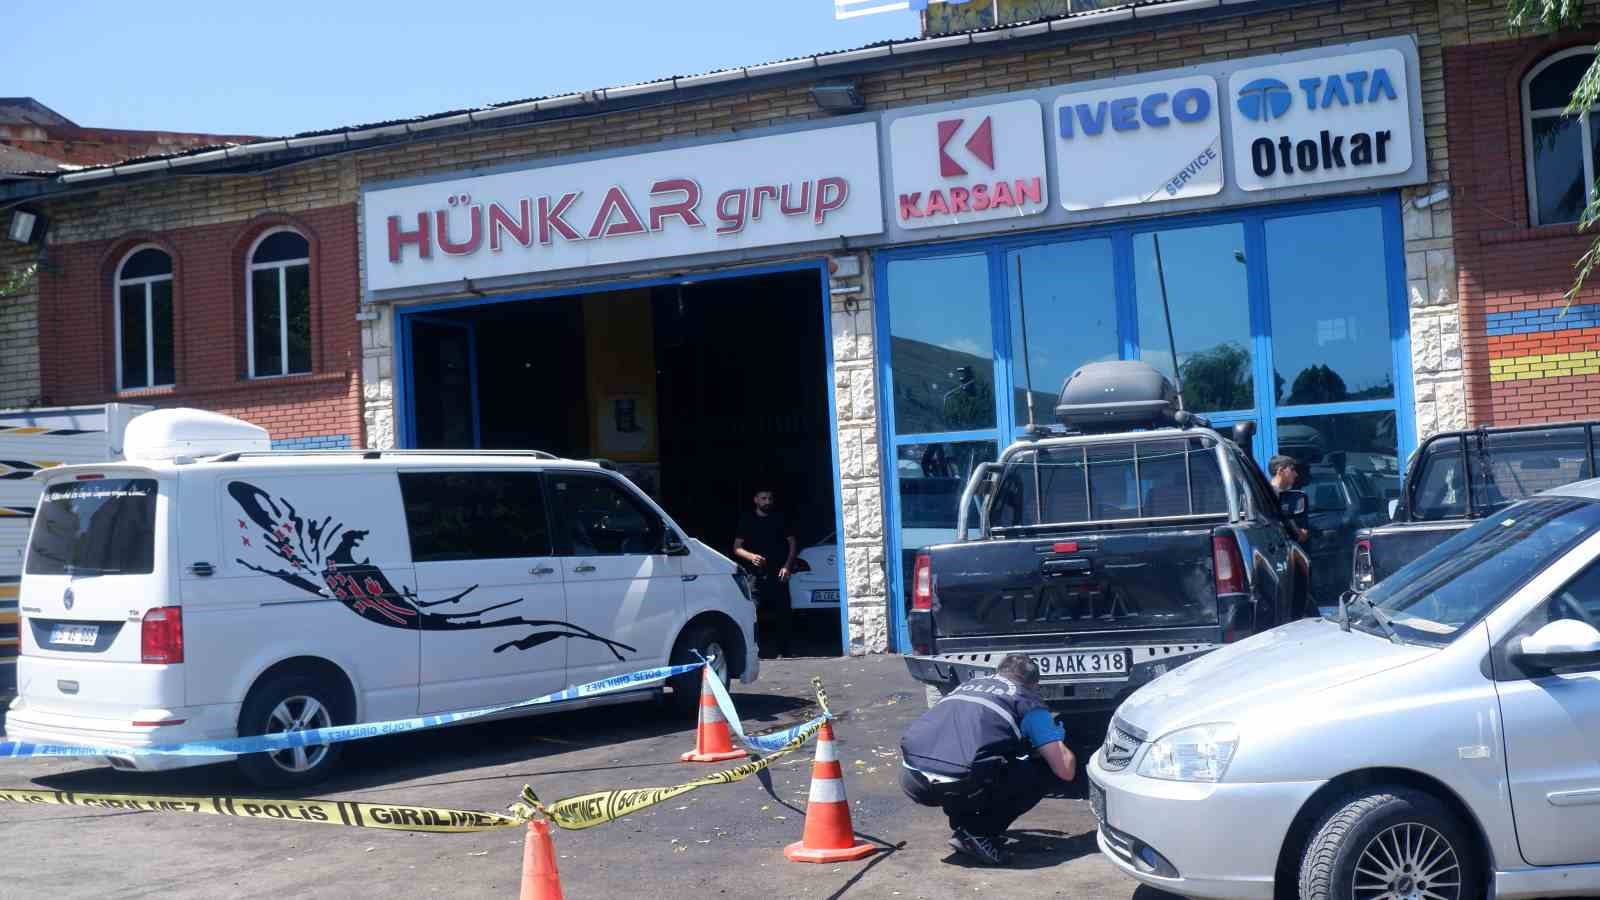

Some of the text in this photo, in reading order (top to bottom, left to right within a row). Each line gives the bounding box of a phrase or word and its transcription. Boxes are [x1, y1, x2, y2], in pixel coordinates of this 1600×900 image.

[1059, 87, 1211, 139] IVECO
[1300, 69, 1398, 109] TATA
[1166, 147, 1216, 196] SERVICE
[1251, 129, 1392, 178] Otokar
[387, 176, 850, 263] HÜNKAR grup
[900, 176, 1042, 220] KARSAN
[1055, 653, 1087, 673] AAK
[1092, 652, 1123, 671] 318
